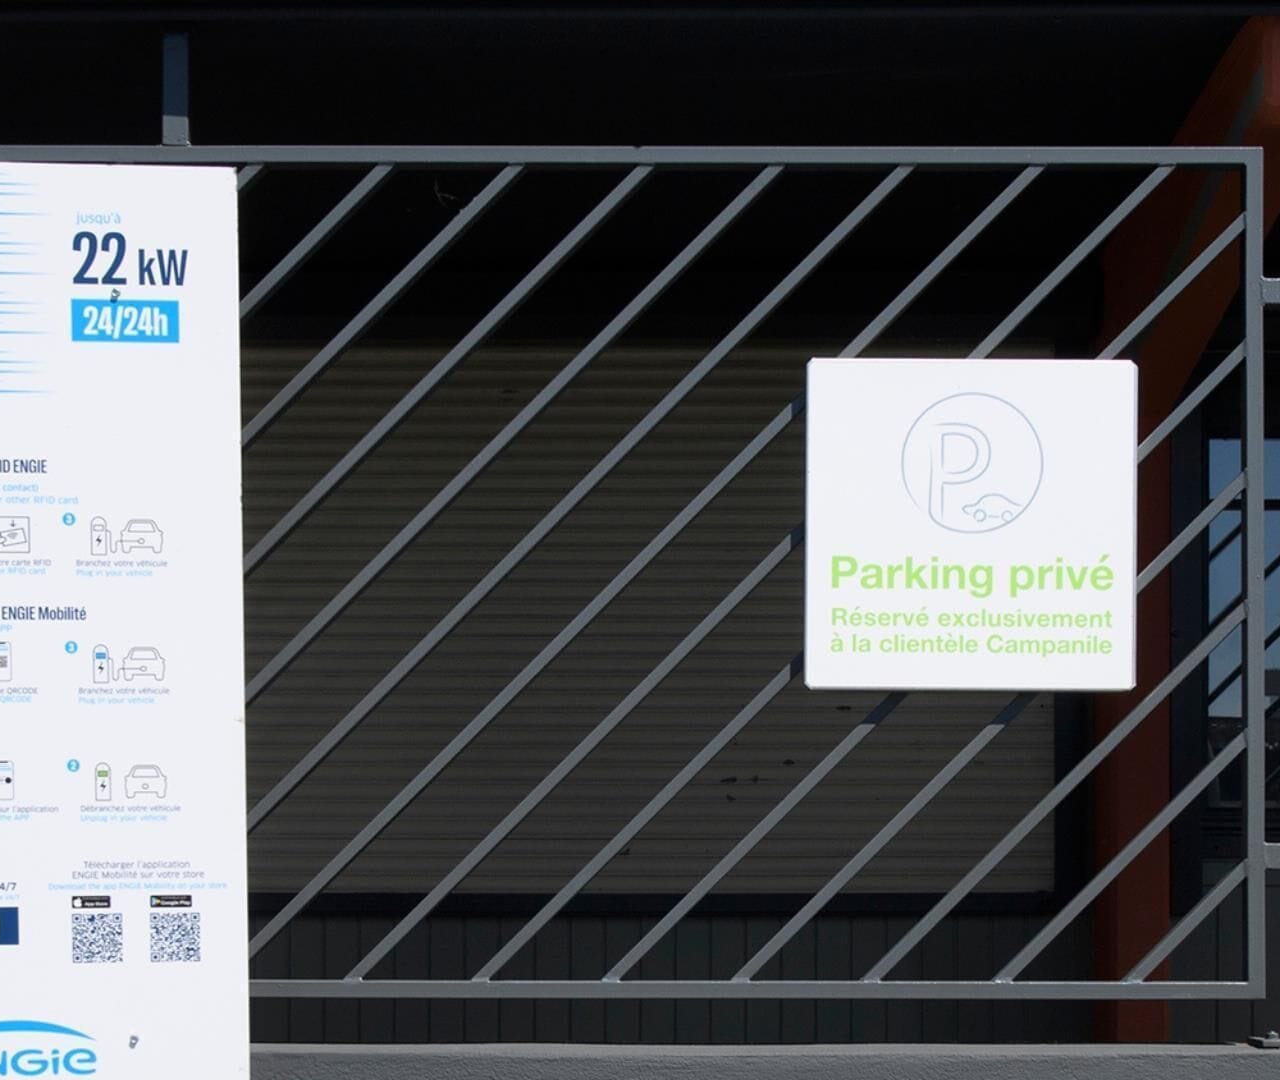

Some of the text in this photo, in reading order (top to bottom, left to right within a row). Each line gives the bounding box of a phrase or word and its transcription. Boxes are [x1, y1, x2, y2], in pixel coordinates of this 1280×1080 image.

[76, 211, 121, 226] jusqu'à
[72, 231, 188, 285] 22 kW
[83, 306, 168, 338] 24/24h
[14, 460, 46, 473] ENGIE
[8, 496, 30, 504] other
[34, 496, 55, 504] RFID
[58, 496, 78, 504] card
[831, 555, 1114, 597] Parking privé
[2, 607, 35, 620] ENGIE
[38, 606, 86, 620] Mobilité
[831, 606, 1112, 628] Réservé exclusivement
[831, 634, 1112, 657] à la clientèle Campanile
[84, 861, 190, 869] Télécharger l'application
[72, 871, 98, 879] ENGIE
[102, 870, 137, 879] Mobilité
